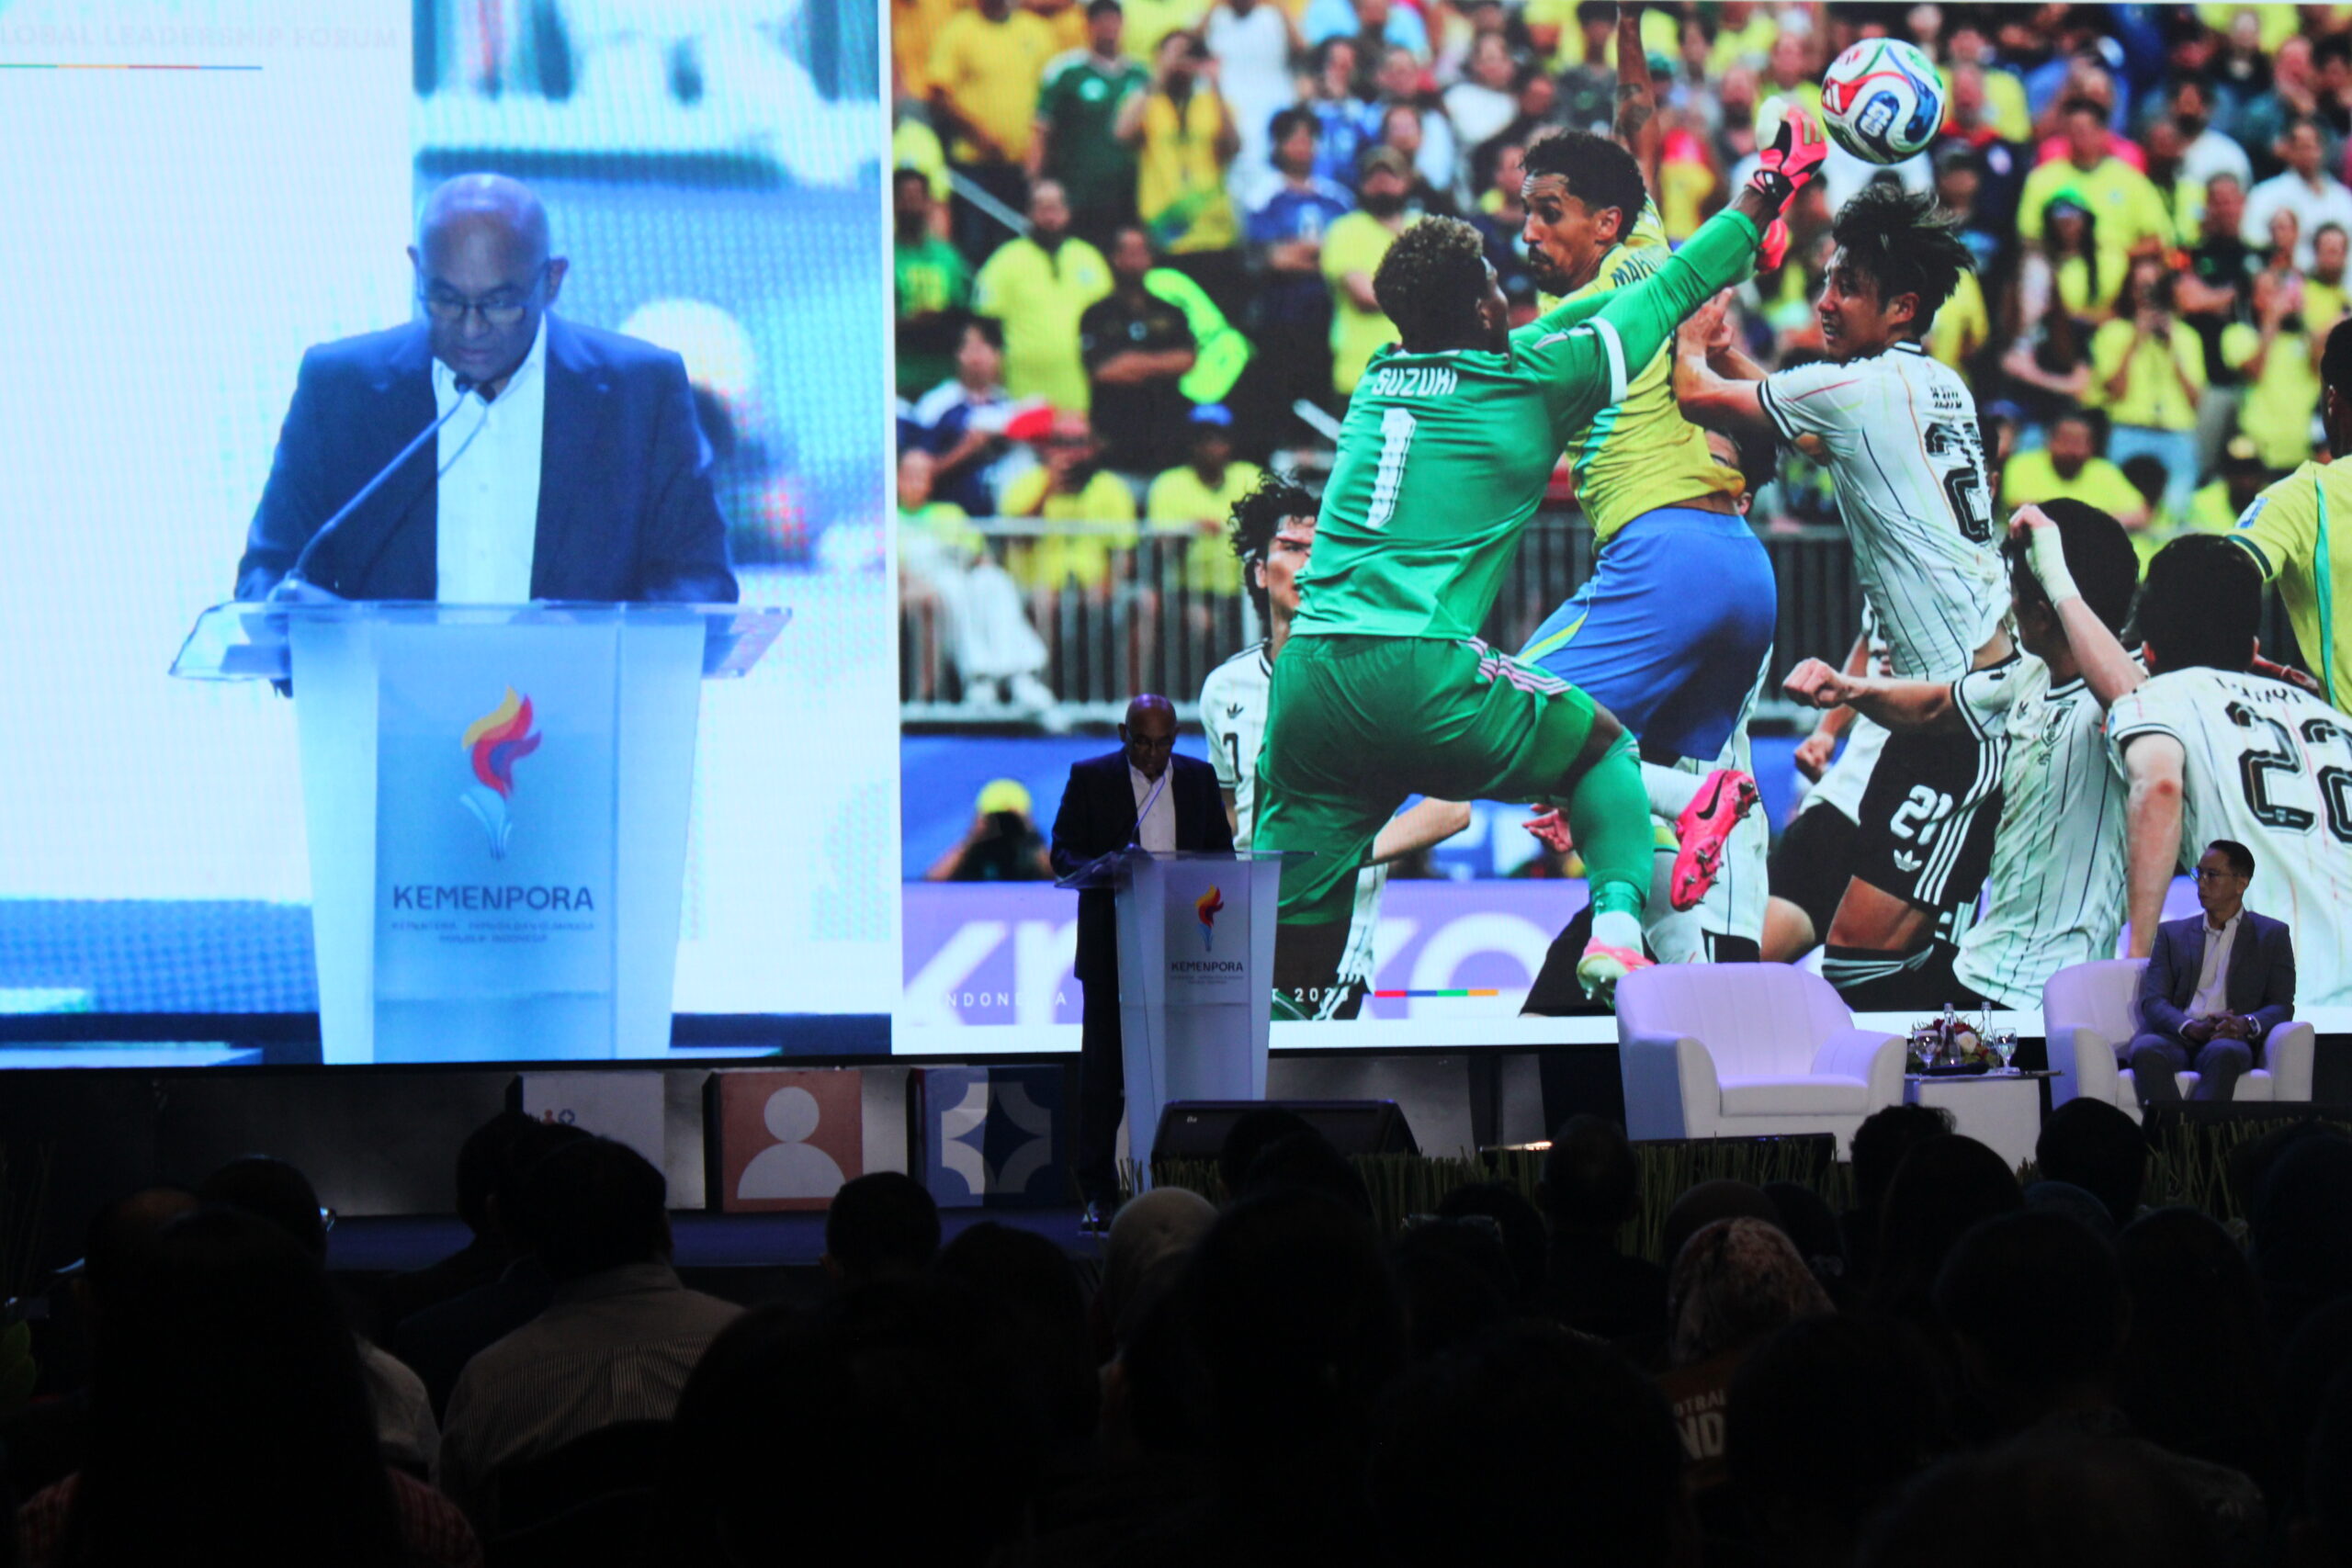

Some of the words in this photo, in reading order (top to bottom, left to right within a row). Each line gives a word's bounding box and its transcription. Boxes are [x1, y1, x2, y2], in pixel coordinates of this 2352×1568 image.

[0, 24, 95, 47] LOBAL
[104, 25, 283, 48] LEADERSHIP
[293, 27, 398, 49] FORUM
[1372, 367, 1458, 397] SUZUKI
[1365, 407, 1417, 529] 1
[1890, 784, 1953, 846] 21
[392, 885, 595, 911] KEMENPORA
[1170, 961, 1244, 974] KEMENPORA
